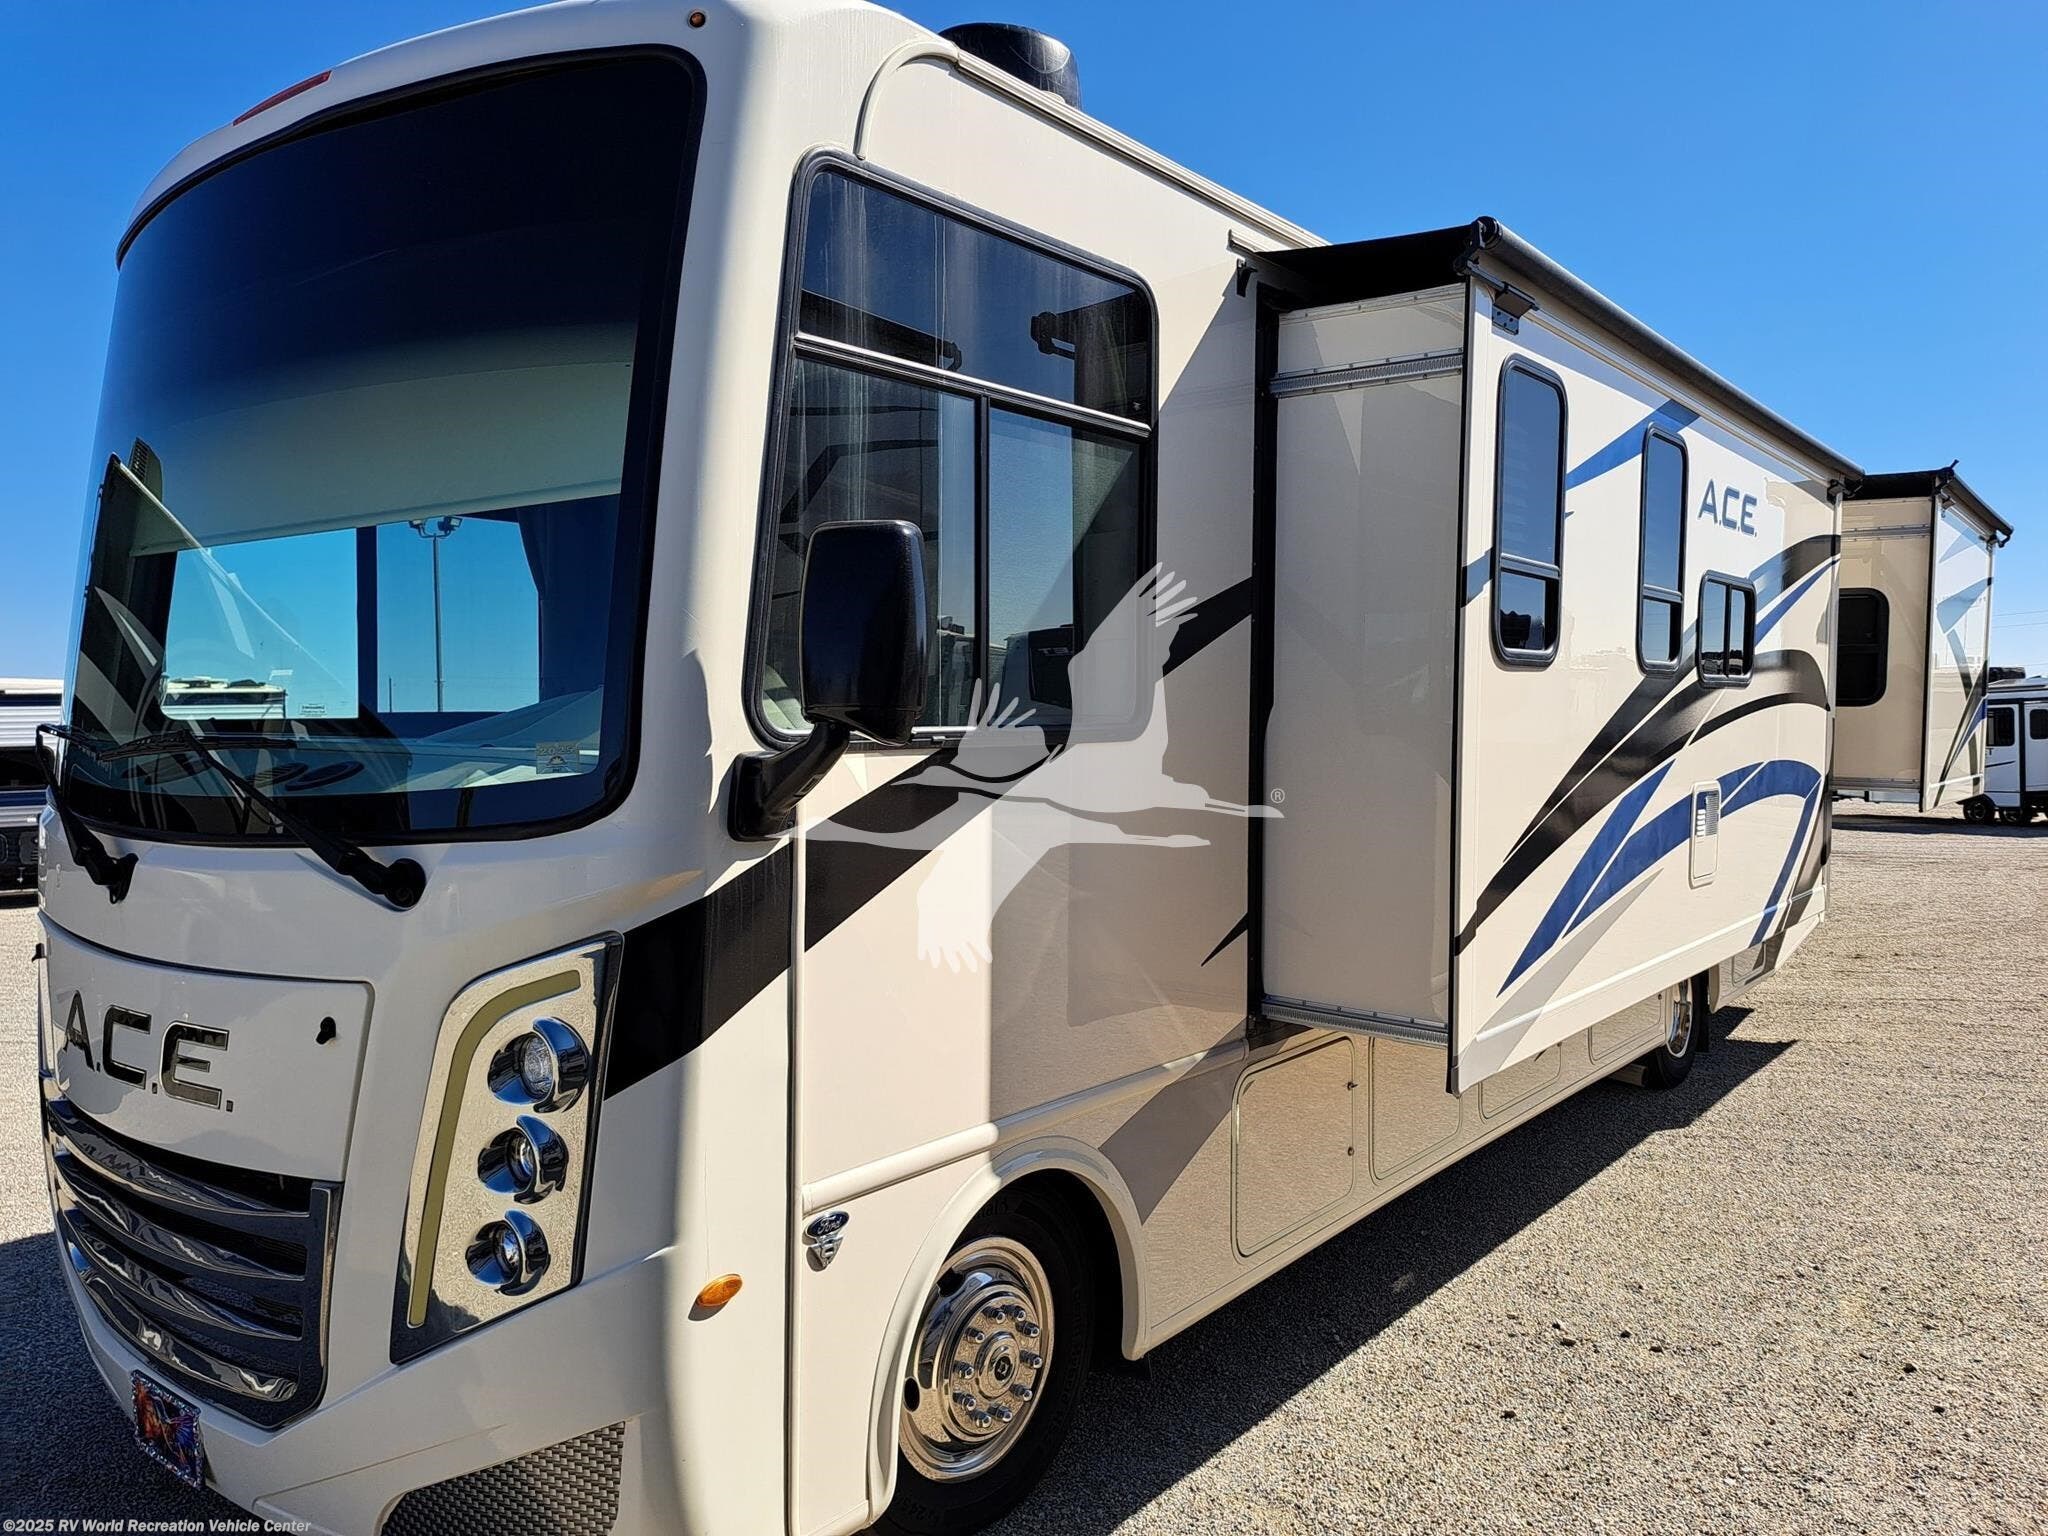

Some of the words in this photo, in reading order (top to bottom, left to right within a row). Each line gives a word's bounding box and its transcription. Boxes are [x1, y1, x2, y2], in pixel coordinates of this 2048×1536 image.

[1697, 479, 1757, 537] A.C.E.
[62, 990, 234, 1112] A.C.E.
[817, 1215, 843, 1234] Ford
